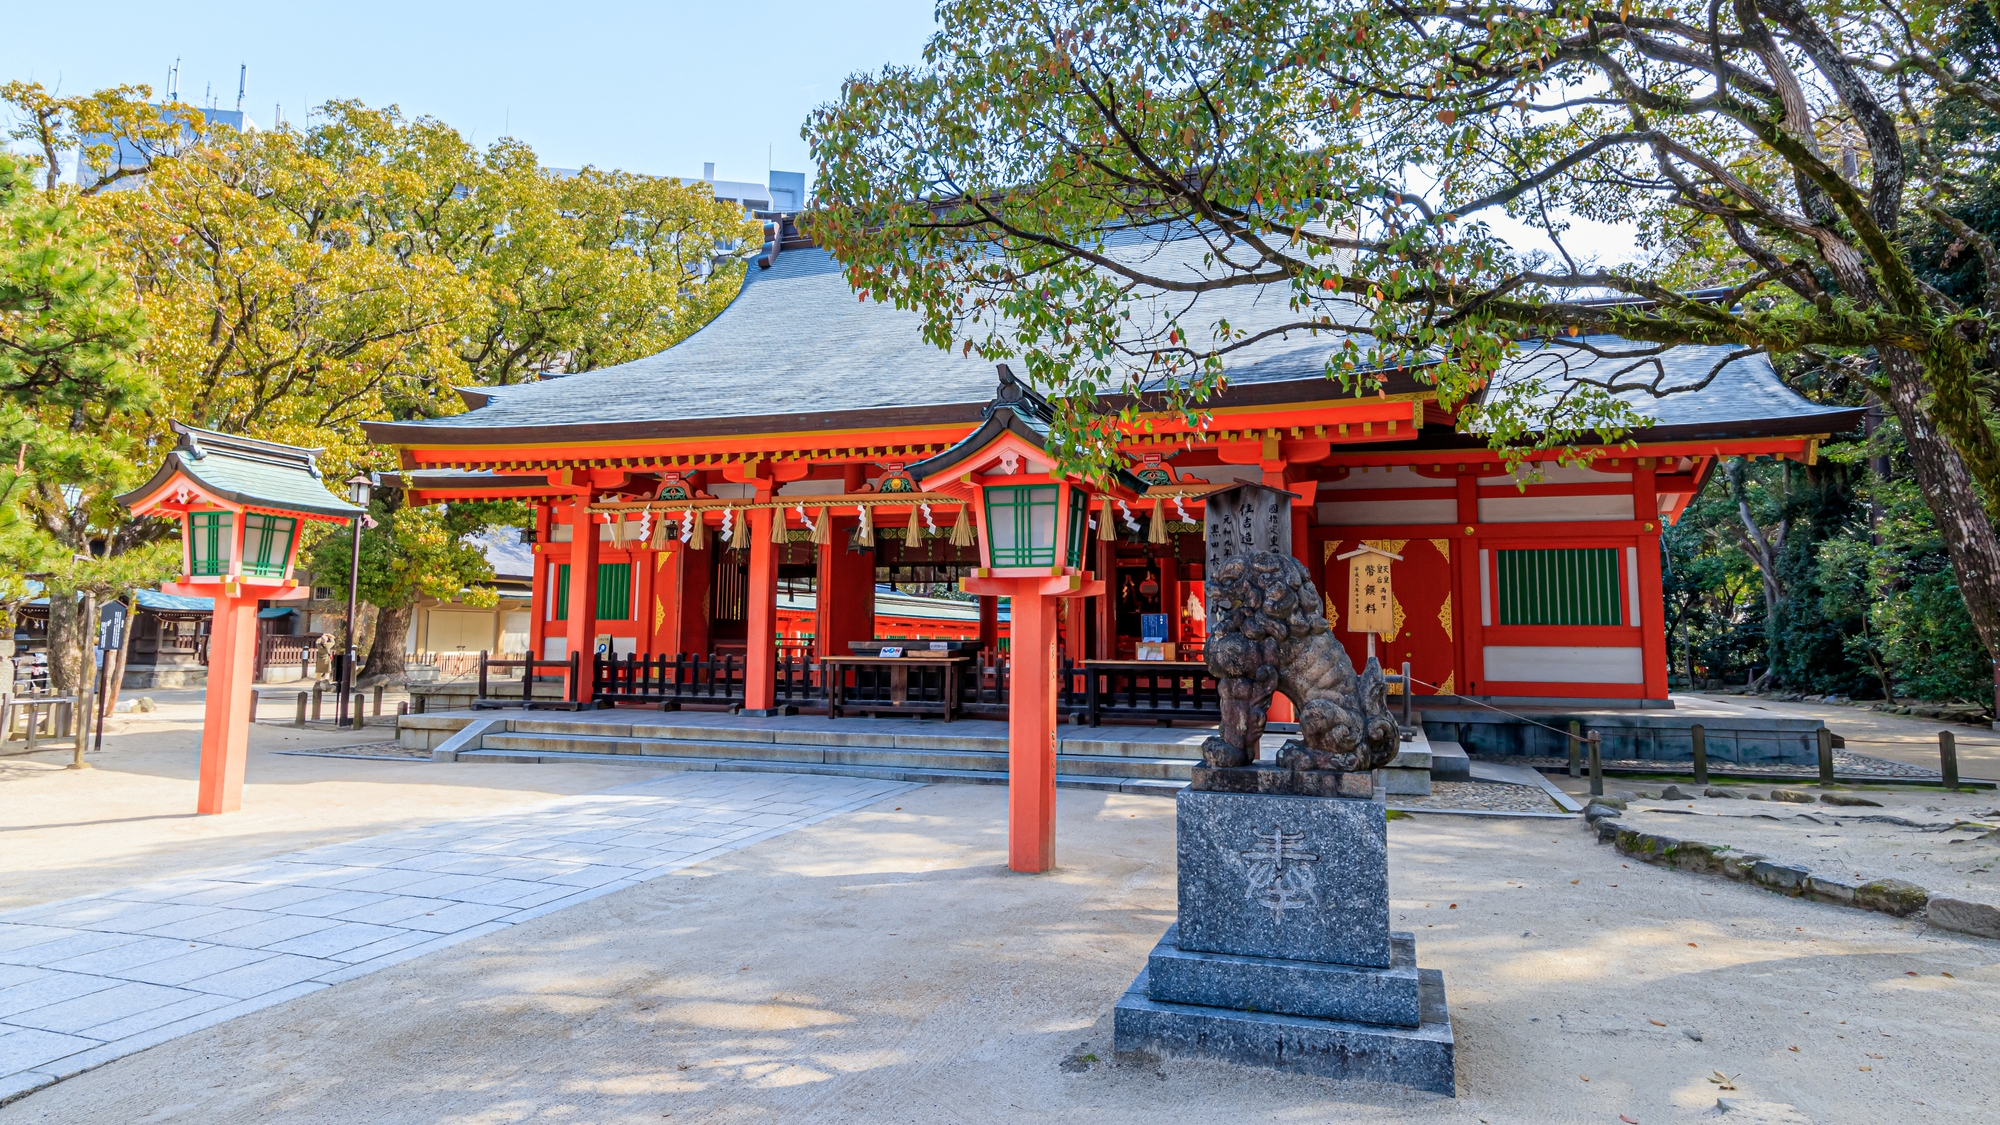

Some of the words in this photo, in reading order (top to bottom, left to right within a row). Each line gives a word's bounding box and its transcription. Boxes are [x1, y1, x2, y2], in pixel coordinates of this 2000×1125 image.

[1239, 503, 1254, 552] 住吉造
[1209, 523, 1221, 569] 黒田長
[1376, 563, 1383, 584] 皇后
[1382, 565, 1390, 584] 天皇
